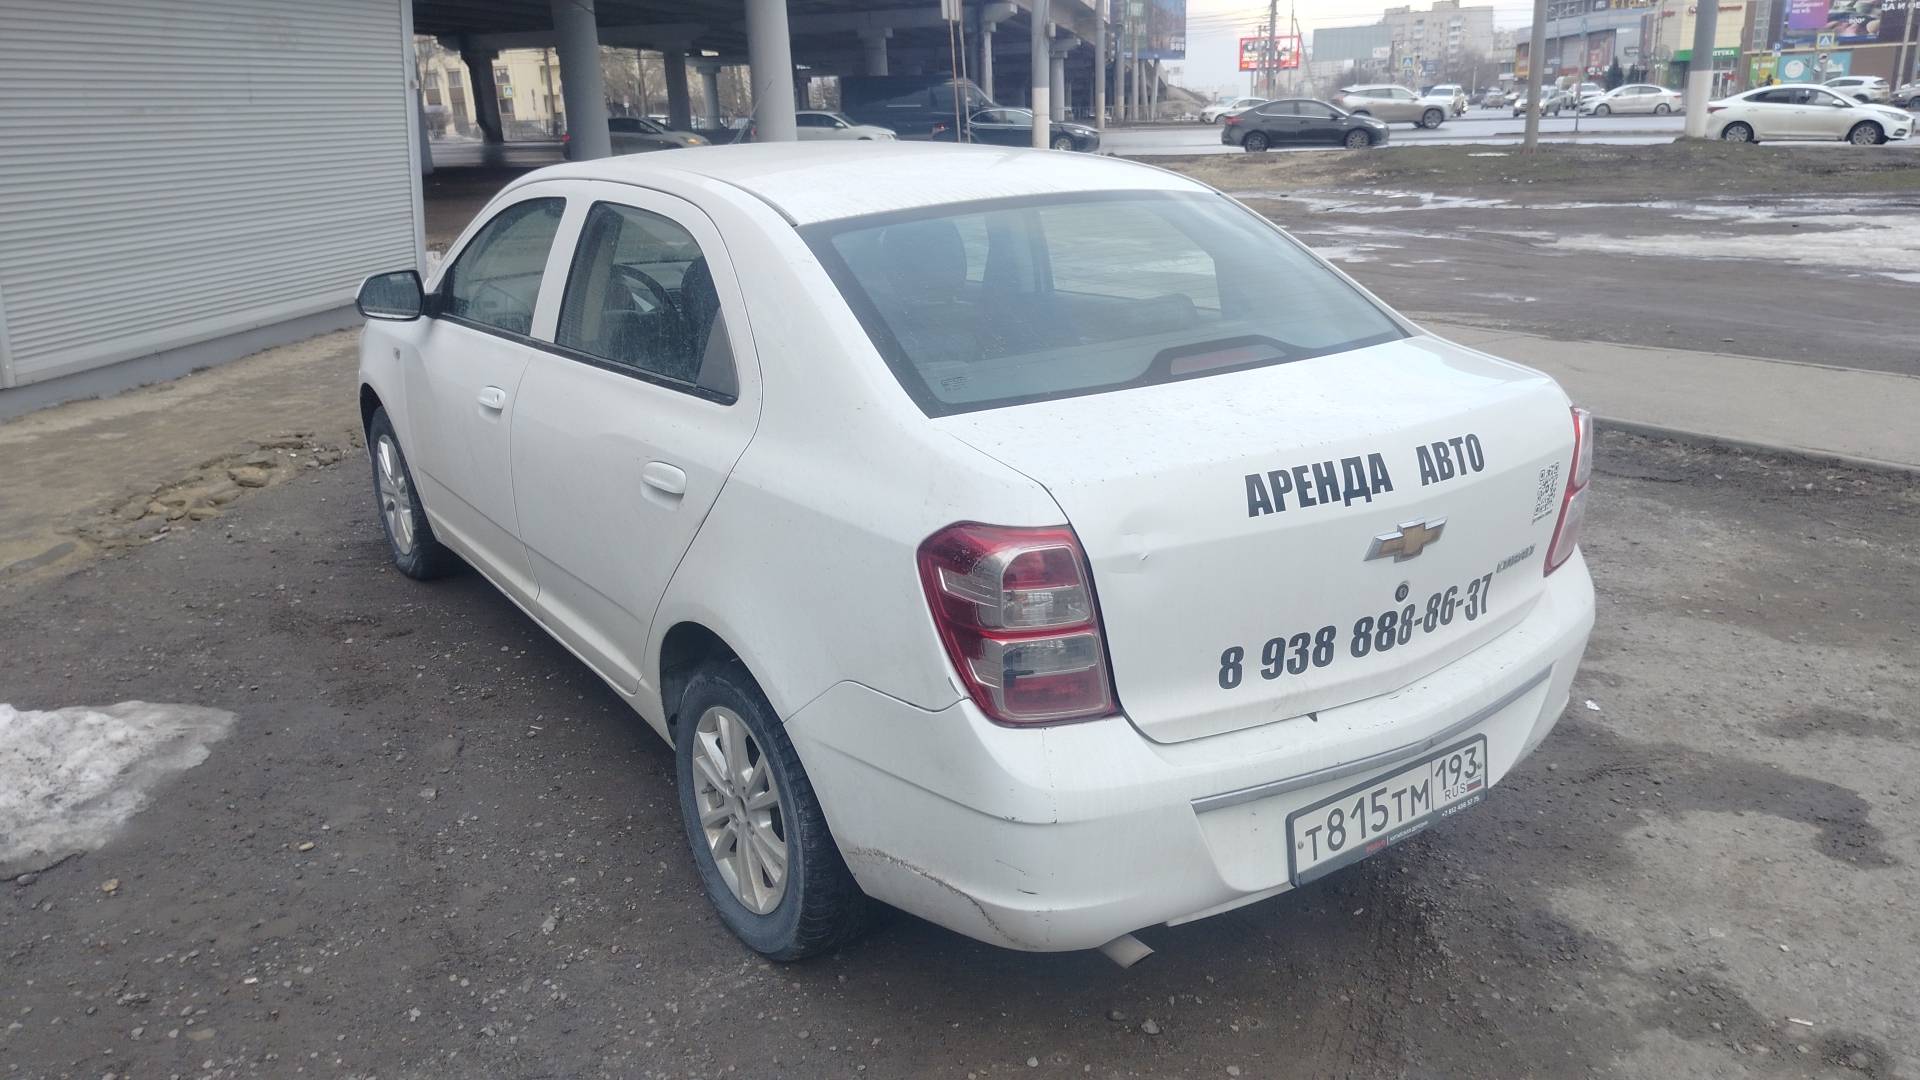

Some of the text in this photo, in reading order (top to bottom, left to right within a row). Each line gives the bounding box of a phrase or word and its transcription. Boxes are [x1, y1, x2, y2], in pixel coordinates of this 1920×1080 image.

[1245, 433, 1485, 518] АРЕНДА АВТО
[1218, 572, 1493, 690] 8 938 888-86-37
[1435, 746, 1477, 790] 193
[1444, 782, 1466, 801] RUS
[1305, 778, 1430, 861] Т815ТМ
